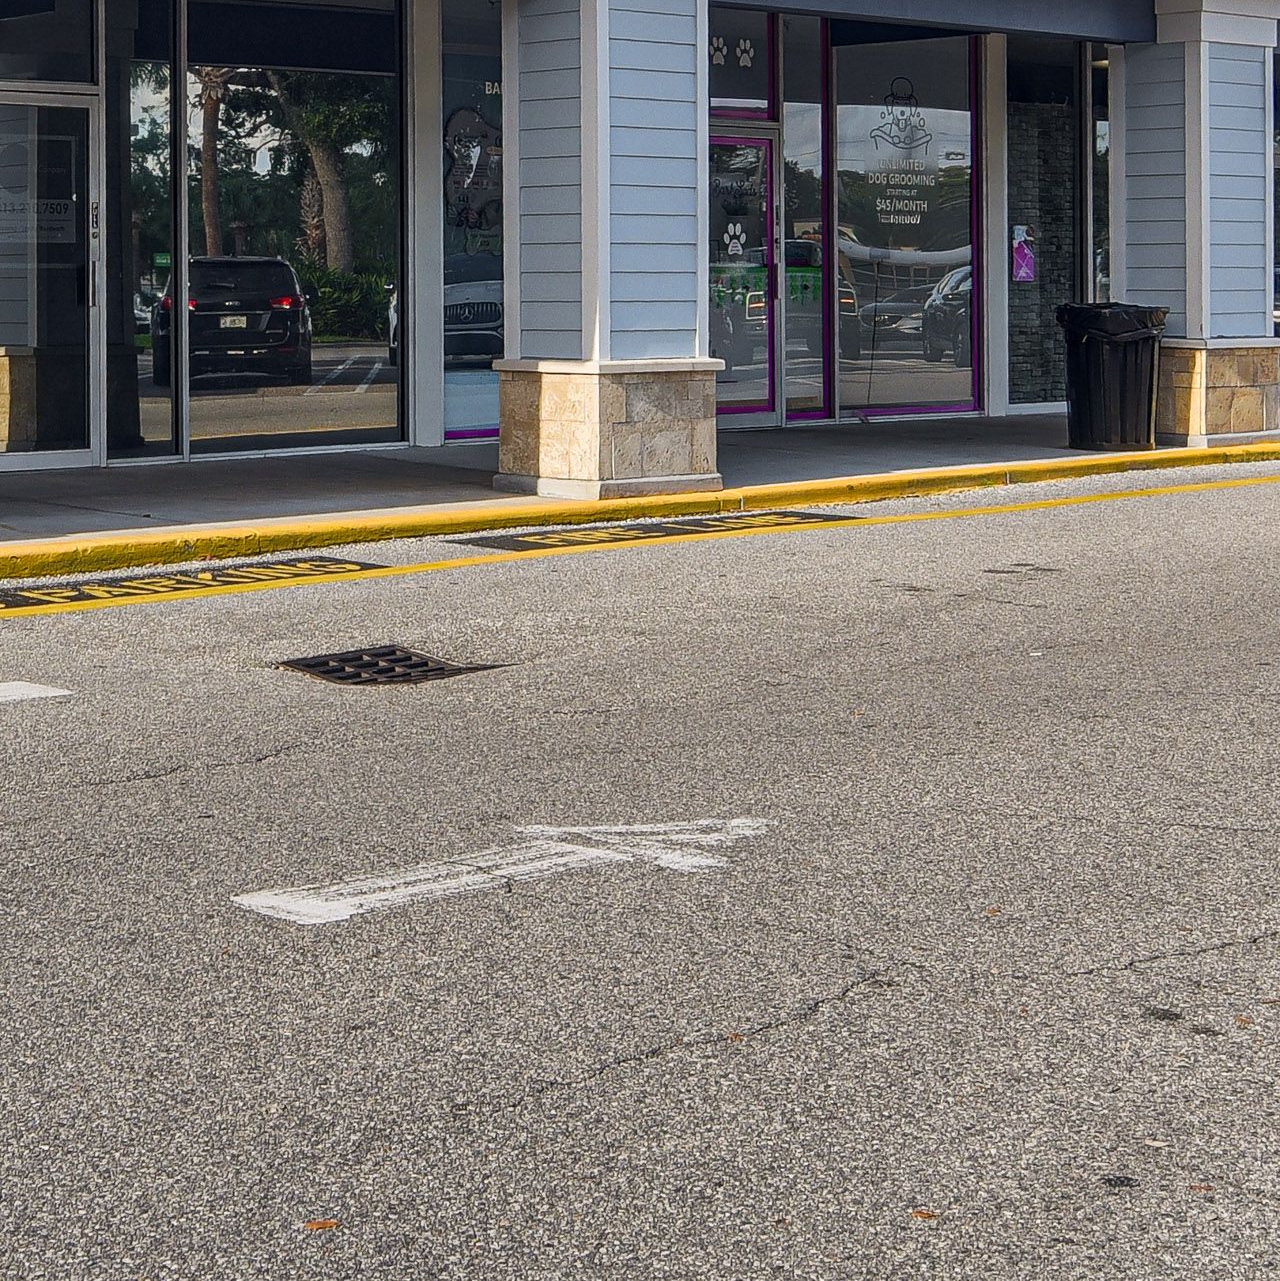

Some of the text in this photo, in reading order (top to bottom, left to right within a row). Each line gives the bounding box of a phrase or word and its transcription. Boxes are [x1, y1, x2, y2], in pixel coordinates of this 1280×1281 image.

[485, 81, 502, 95] BA
[878, 158, 926, 171] UNLIMITED
[868, 172, 935, 186] DOG GROOMING
[876, 197, 928, 212] $45/MONTH
[516, 515, 824, 546] FIRE LANE
[22, 560, 363, 605] PARKING
